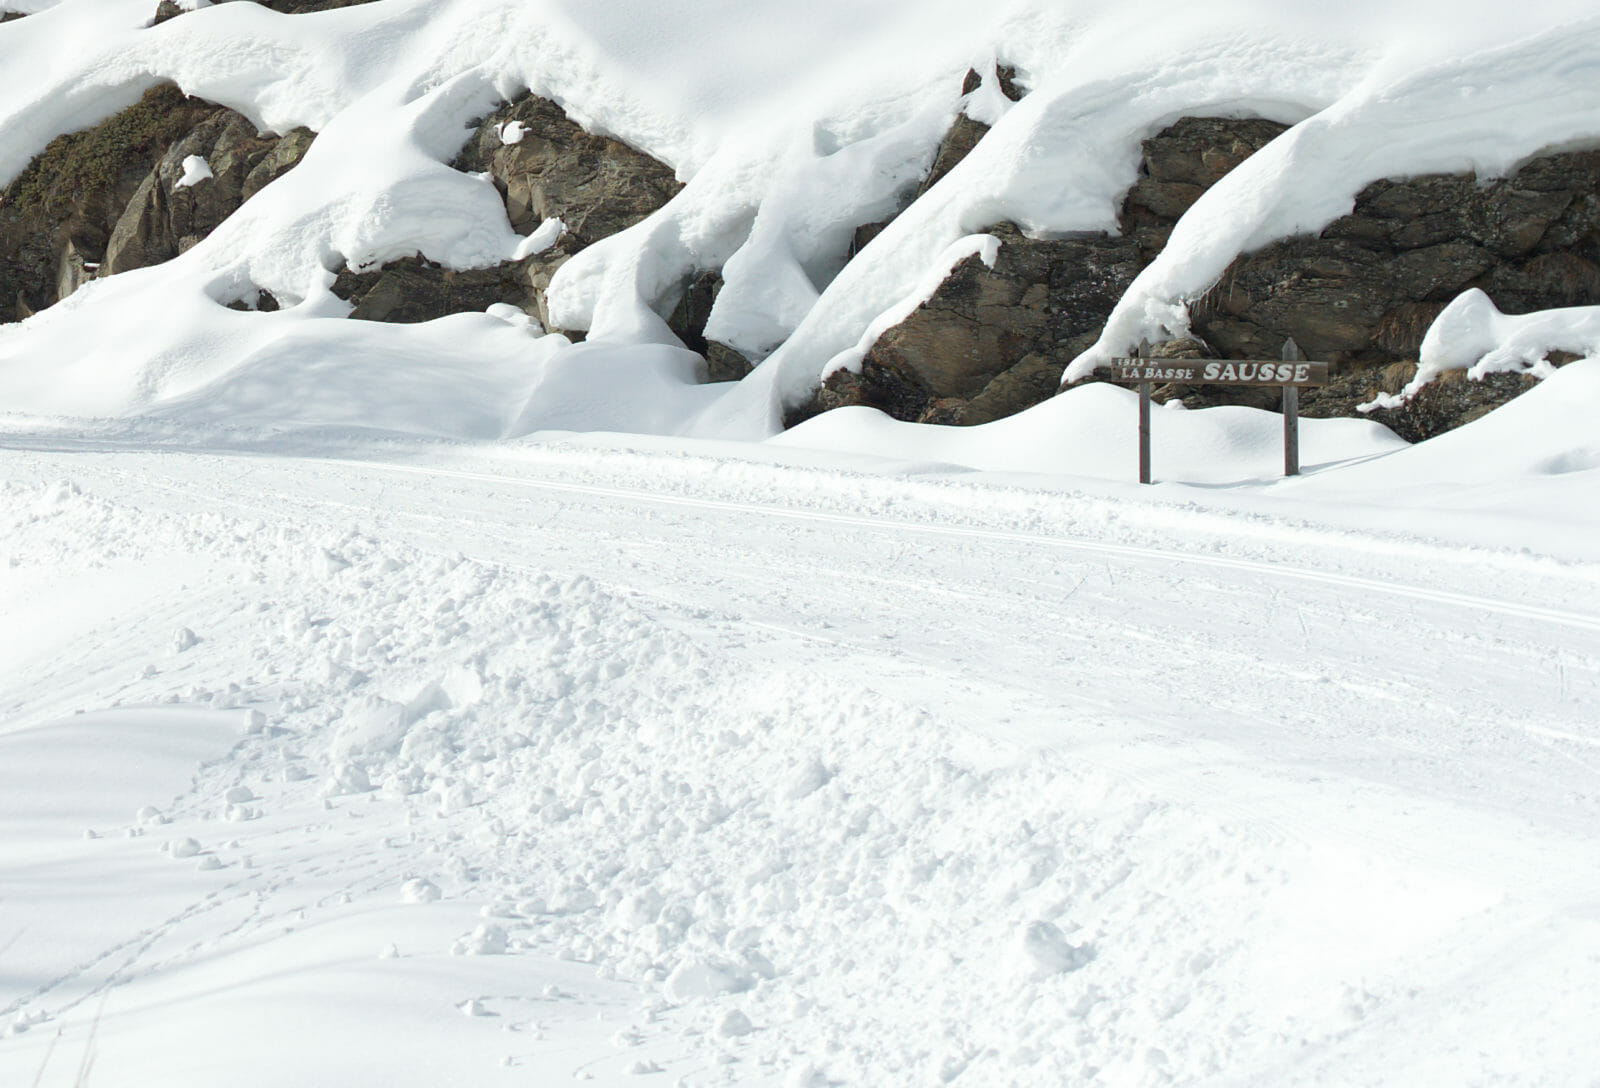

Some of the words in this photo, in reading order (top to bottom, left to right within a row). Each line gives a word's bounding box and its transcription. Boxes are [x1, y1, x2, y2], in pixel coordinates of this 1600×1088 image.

[1121, 367, 1140, 378] LA
[1144, 367, 1194, 379] BASSE
[1203, 362, 1310, 382] SAUSSE
